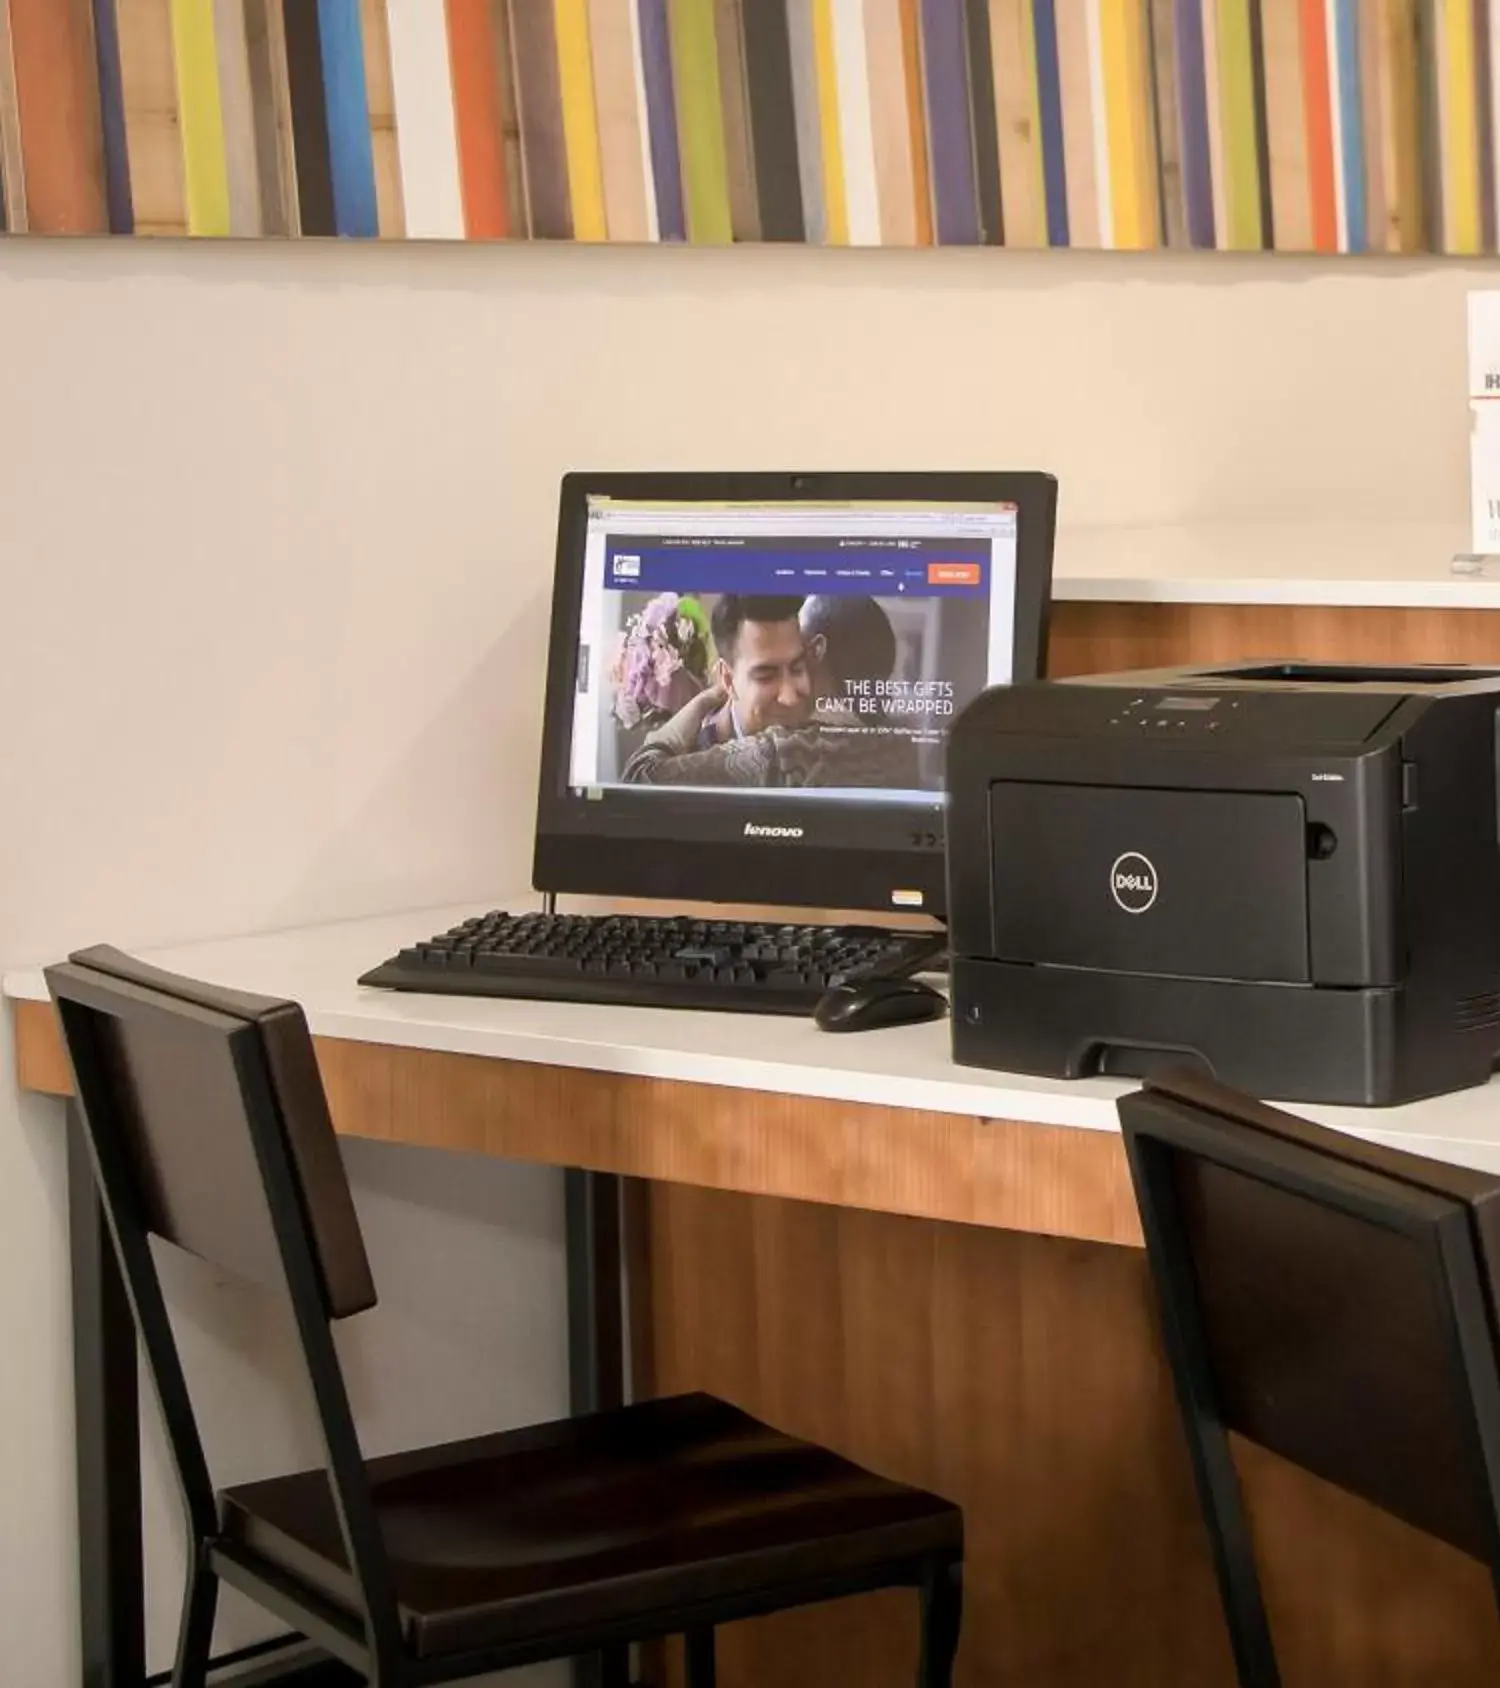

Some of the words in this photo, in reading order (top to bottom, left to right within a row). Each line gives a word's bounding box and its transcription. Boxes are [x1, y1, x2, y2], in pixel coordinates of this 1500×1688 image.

[845, 679, 871, 695] THE
[875, 680, 910, 696] BEST
[913, 681, 954, 697] GIFTS
[815, 698, 854, 713] CAN'T
[859, 698, 878, 713] BE
[881, 699, 953, 715] WRAPPED
[744, 822, 804, 838] lenovo
[1115, 873, 1153, 891] DELL
